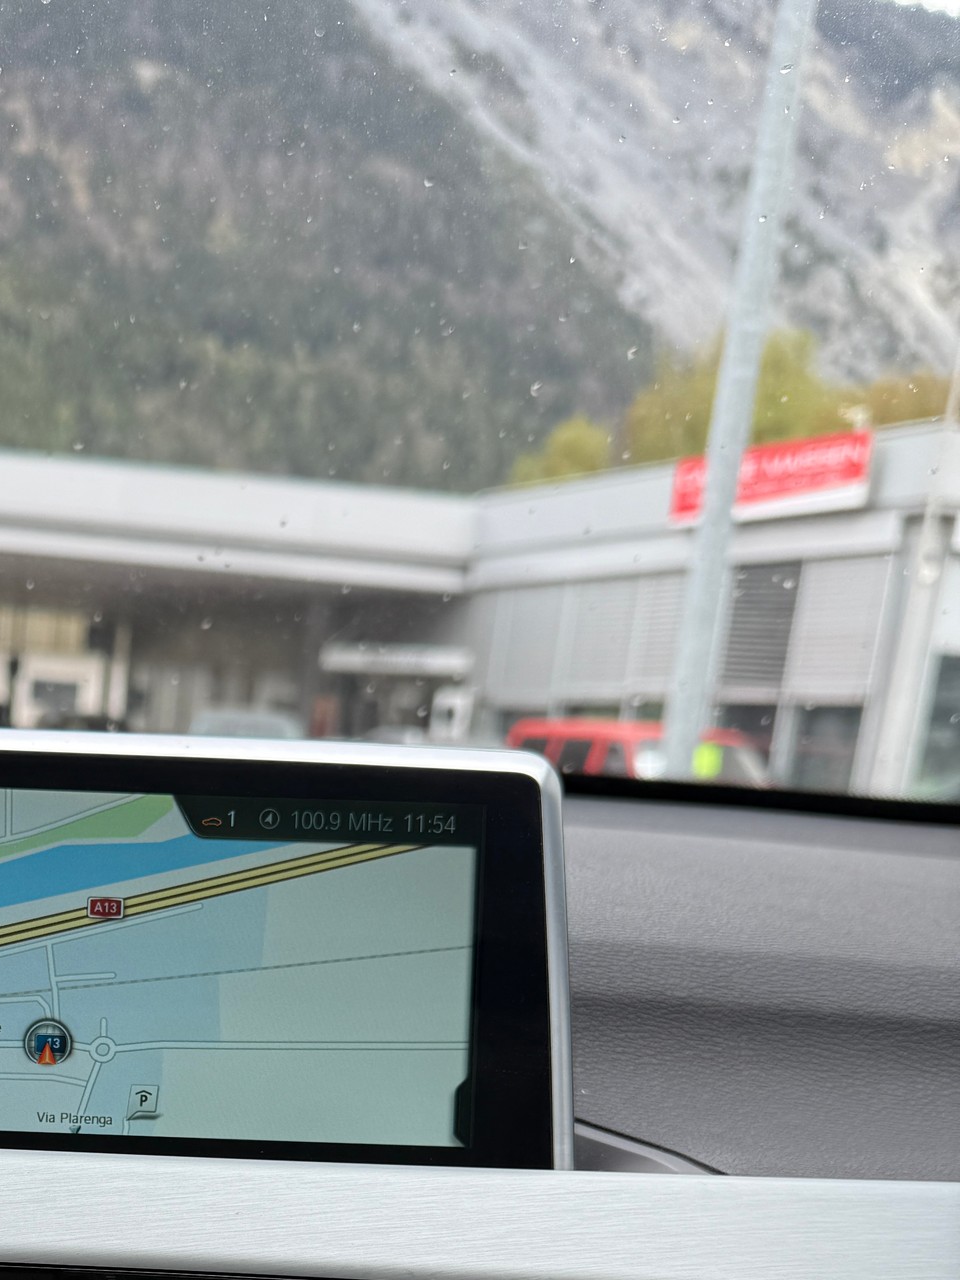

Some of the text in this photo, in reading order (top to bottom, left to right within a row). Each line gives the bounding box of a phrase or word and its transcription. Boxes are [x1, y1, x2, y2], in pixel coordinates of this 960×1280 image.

[227, 810, 235, 828] 1
[291, 811, 393, 832] 100.9 MHz
[404, 814, 456, 834] 11:54
[93, 902, 118, 914] A13
[36, 1111, 113, 1127] Via Plarenga
